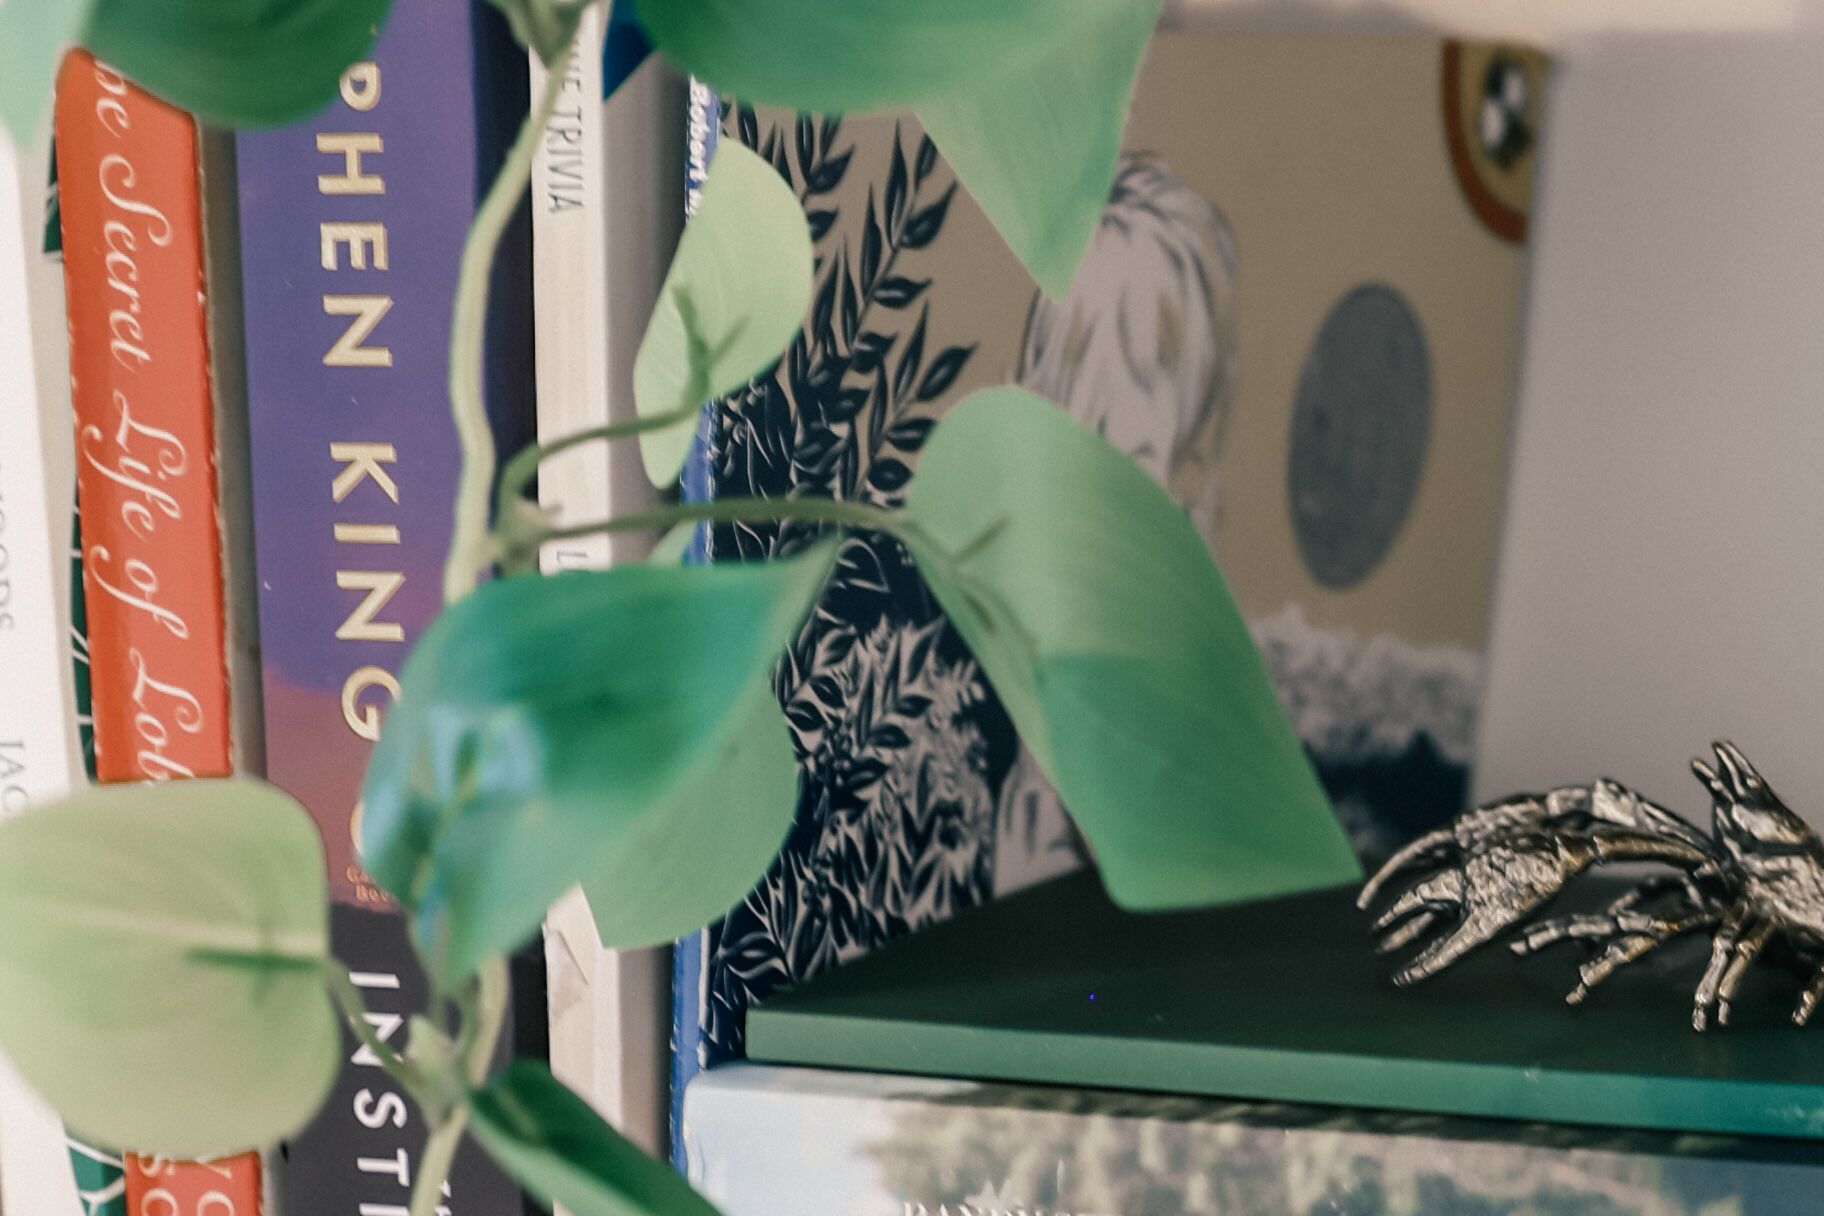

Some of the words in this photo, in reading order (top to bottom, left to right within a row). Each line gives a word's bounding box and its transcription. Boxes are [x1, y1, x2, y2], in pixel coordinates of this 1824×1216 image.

[546, 105, 584, 213] TRIVIA
[100, 154, 174, 373] Secret
[82, 389, 187, 544] Life
[89, 545, 190, 641] of
[330, 441, 406, 743] KING
